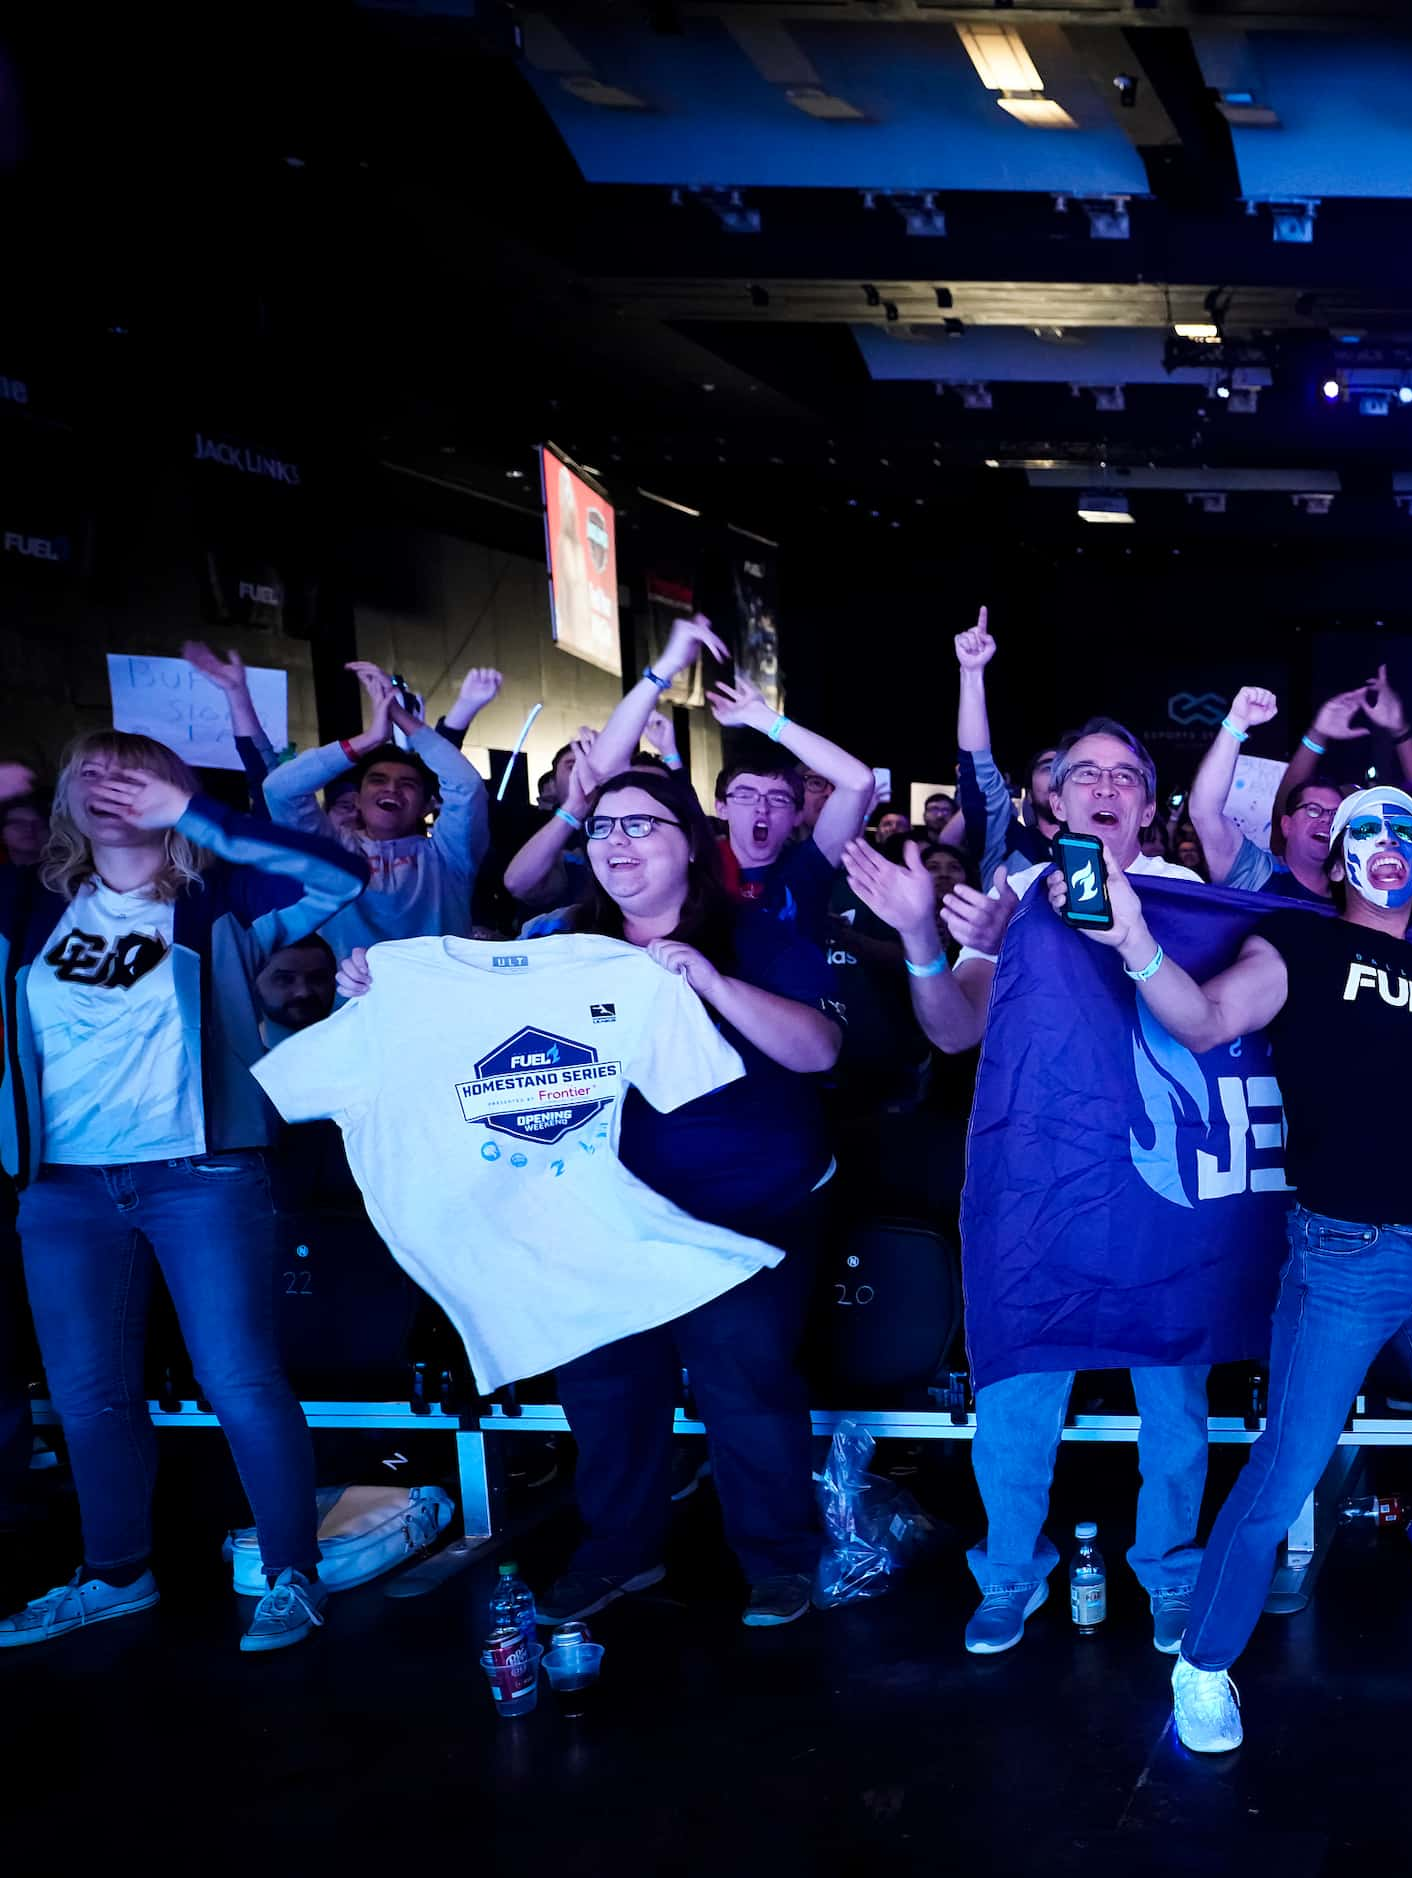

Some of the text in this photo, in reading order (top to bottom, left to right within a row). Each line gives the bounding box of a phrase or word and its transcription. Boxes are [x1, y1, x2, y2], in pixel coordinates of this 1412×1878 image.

[192, 432, 245, 472] JACK
[3, 530, 60, 560] FUEL
[511, 1053, 551, 1069] FUEL
[462, 1065, 617, 1099] HOMESTAND SERIES
[538, 1086, 591, 1102] Frontier
[516, 1110, 573, 1128] OPENING
[524, 1118, 569, 1133] WEEKEND
[282, 1271, 313, 1295] 22
[833, 1284, 874, 1305] 20
